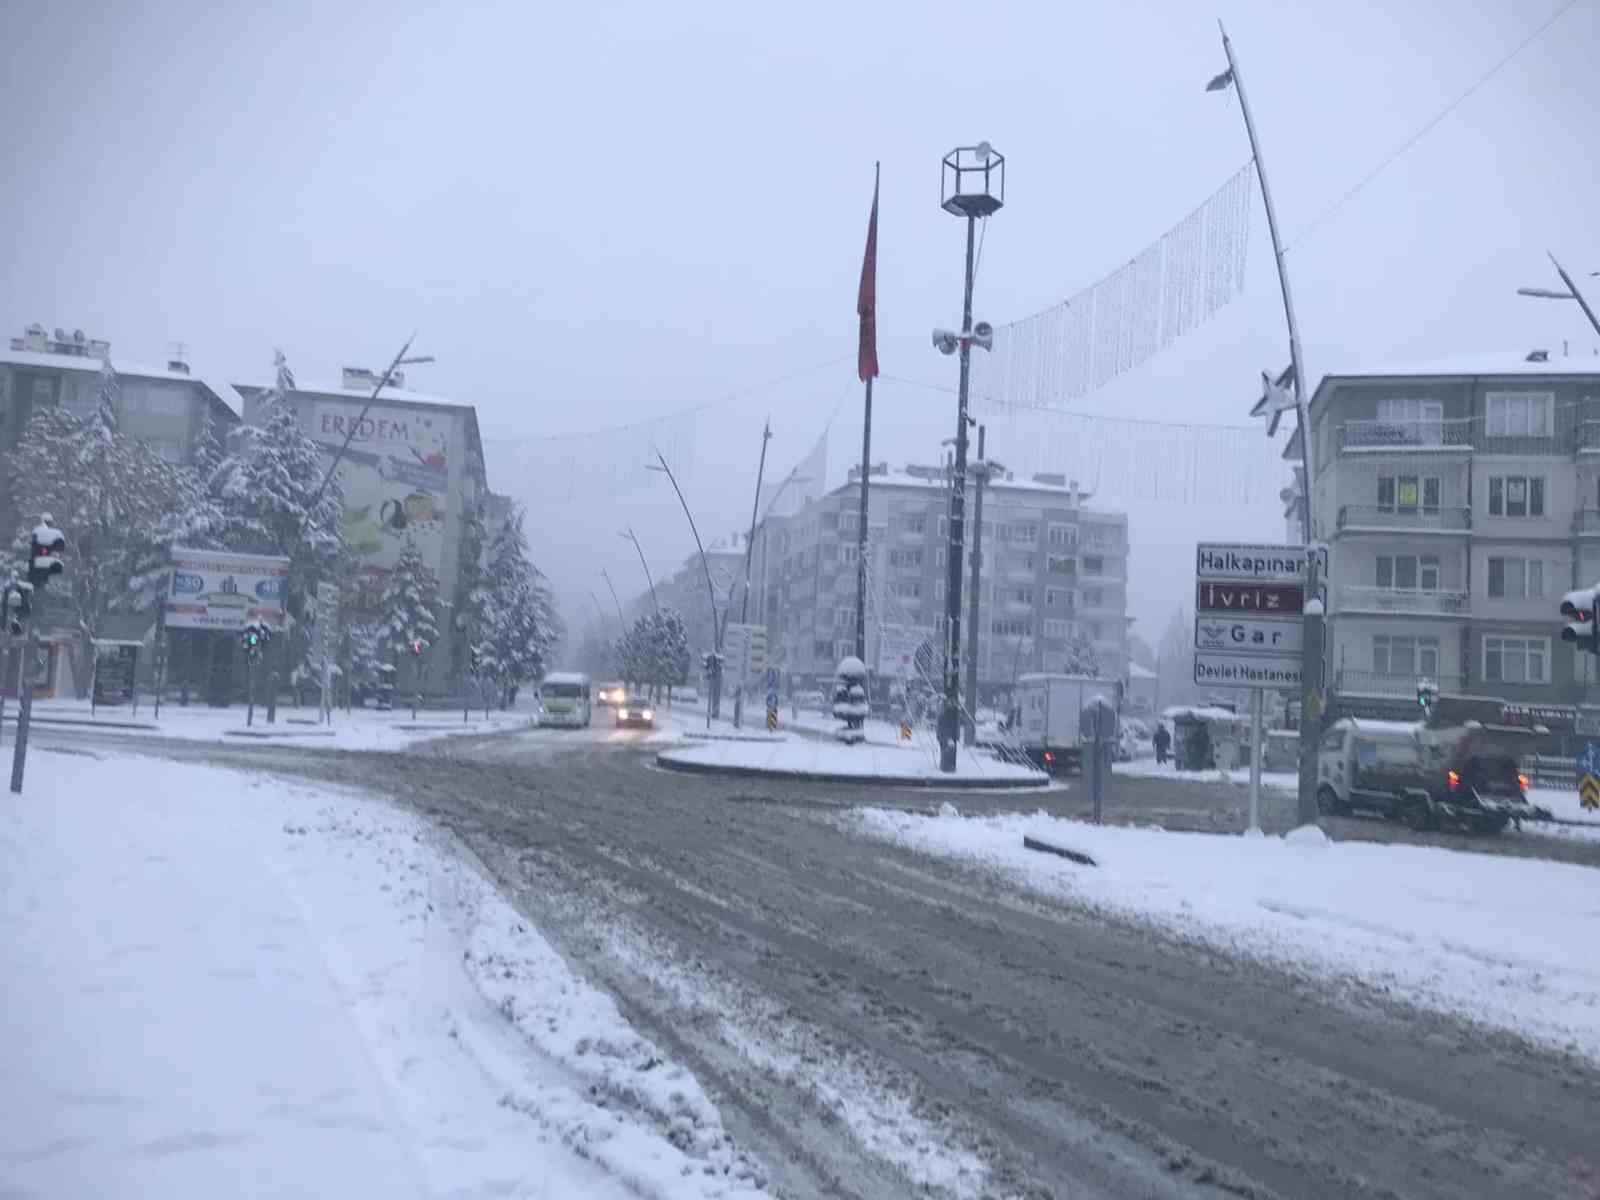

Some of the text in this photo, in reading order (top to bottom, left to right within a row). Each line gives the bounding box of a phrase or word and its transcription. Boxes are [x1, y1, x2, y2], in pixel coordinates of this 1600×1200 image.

[1200, 552, 1305, 575] Halkapınar
[1231, 625, 1282, 645] Gar
[1197, 662, 1238, 679] Devlet
